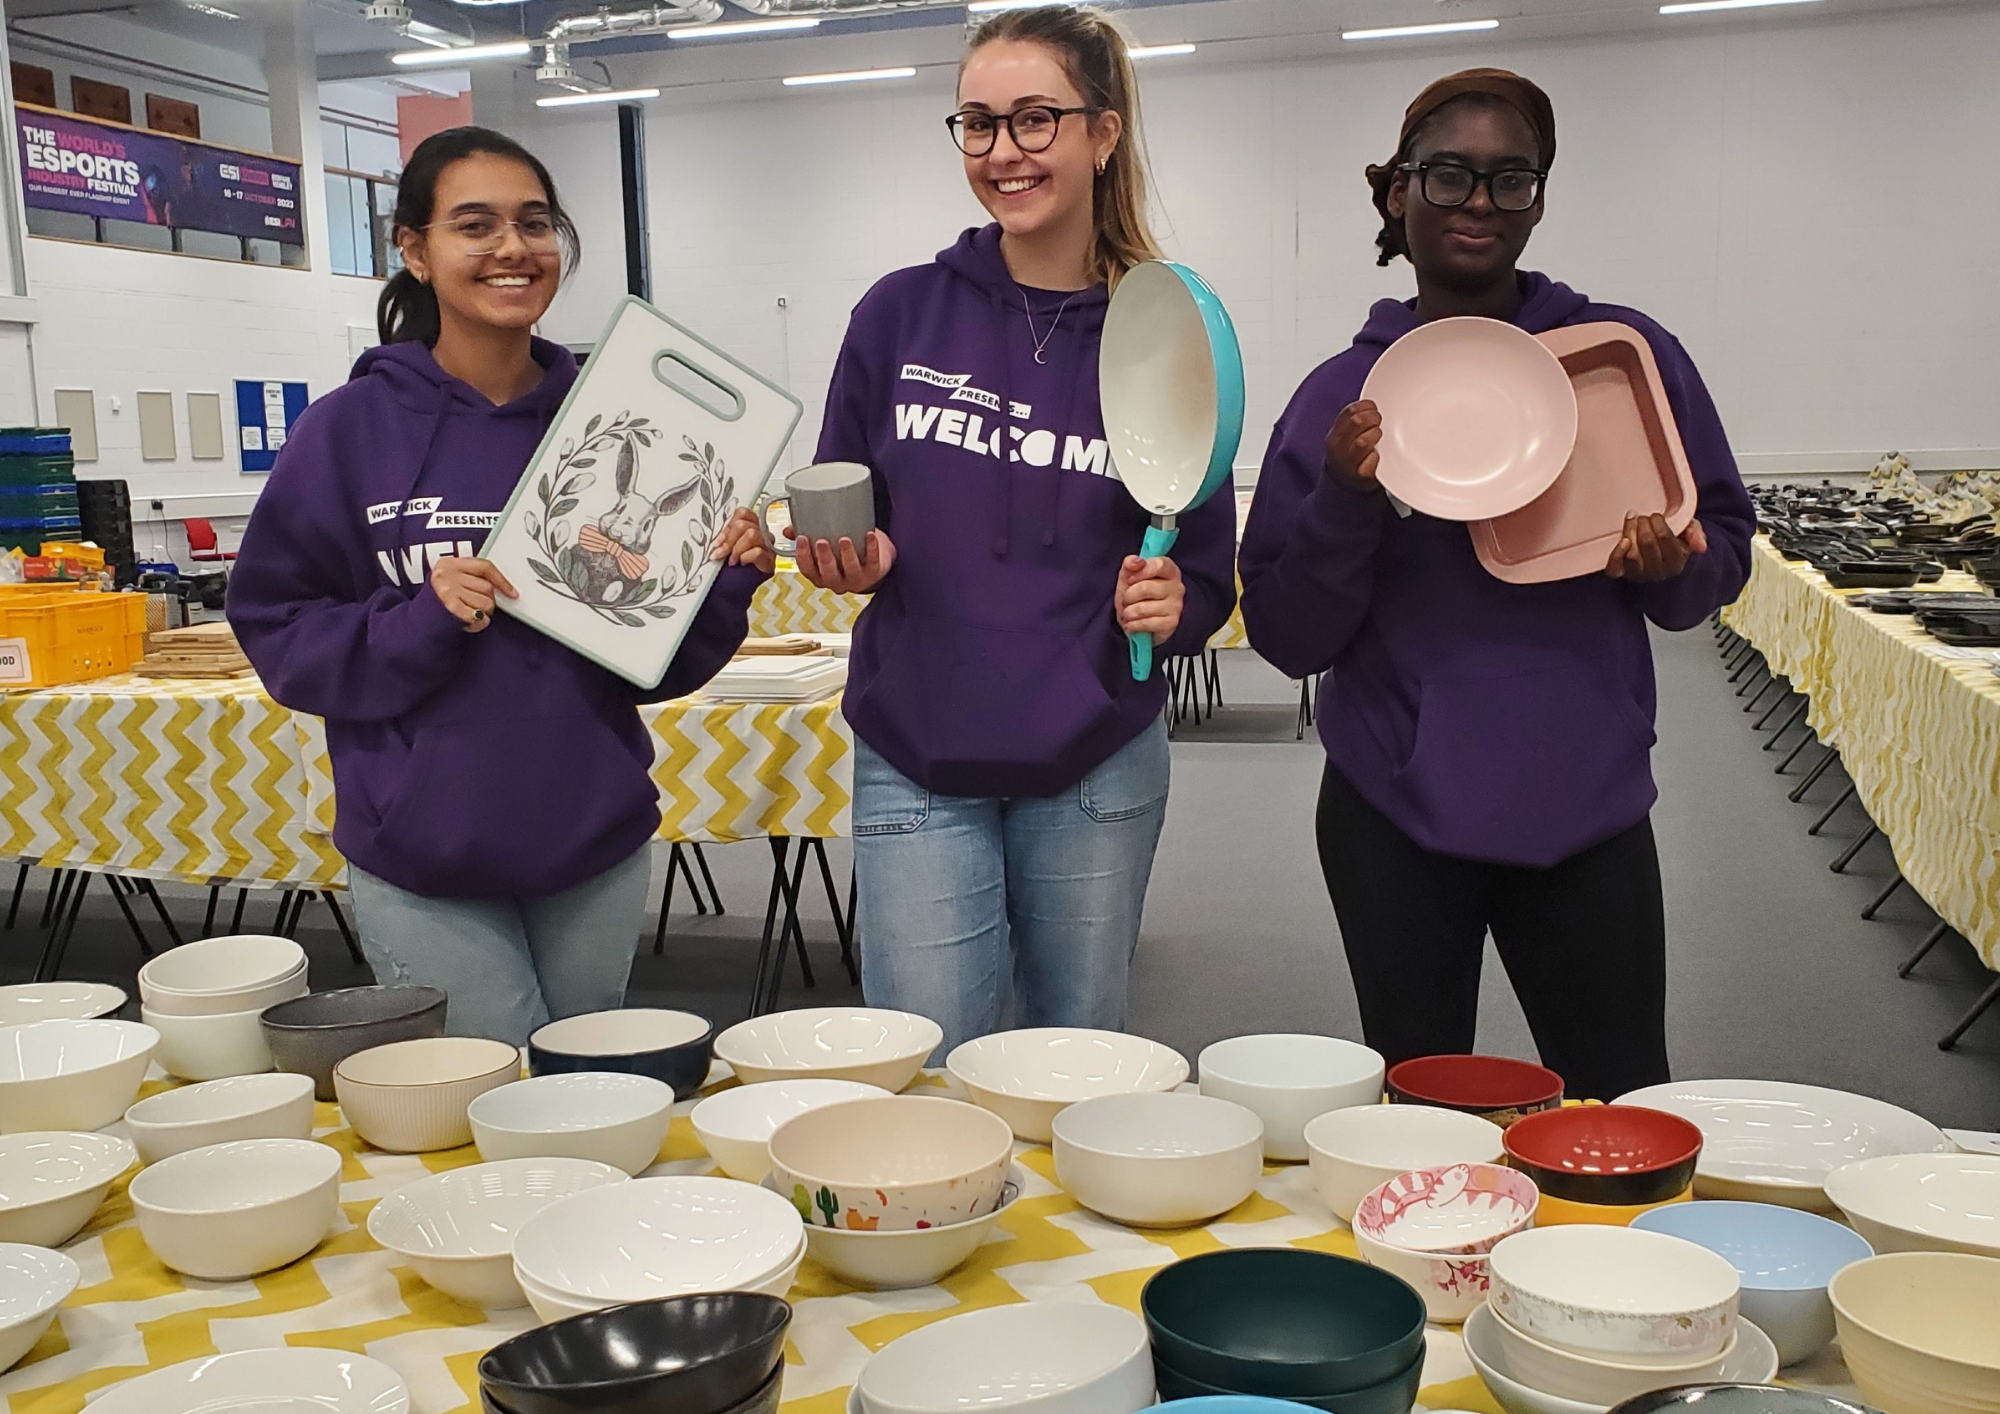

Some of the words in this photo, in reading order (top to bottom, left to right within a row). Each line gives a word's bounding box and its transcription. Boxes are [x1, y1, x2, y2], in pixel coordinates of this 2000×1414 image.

[23, 125, 56, 147] THE
[57, 132, 126, 159] WORLD'S
[26, 143, 140, 186] ESPORTS
[27, 169, 86, 189] INDUSTRY
[87, 178, 138, 197] FESTIVAL
[28, 183, 42, 192] OUR
[905, 367, 962, 386] WARWICK
[958, 389, 1028, 416] PRESENS...
